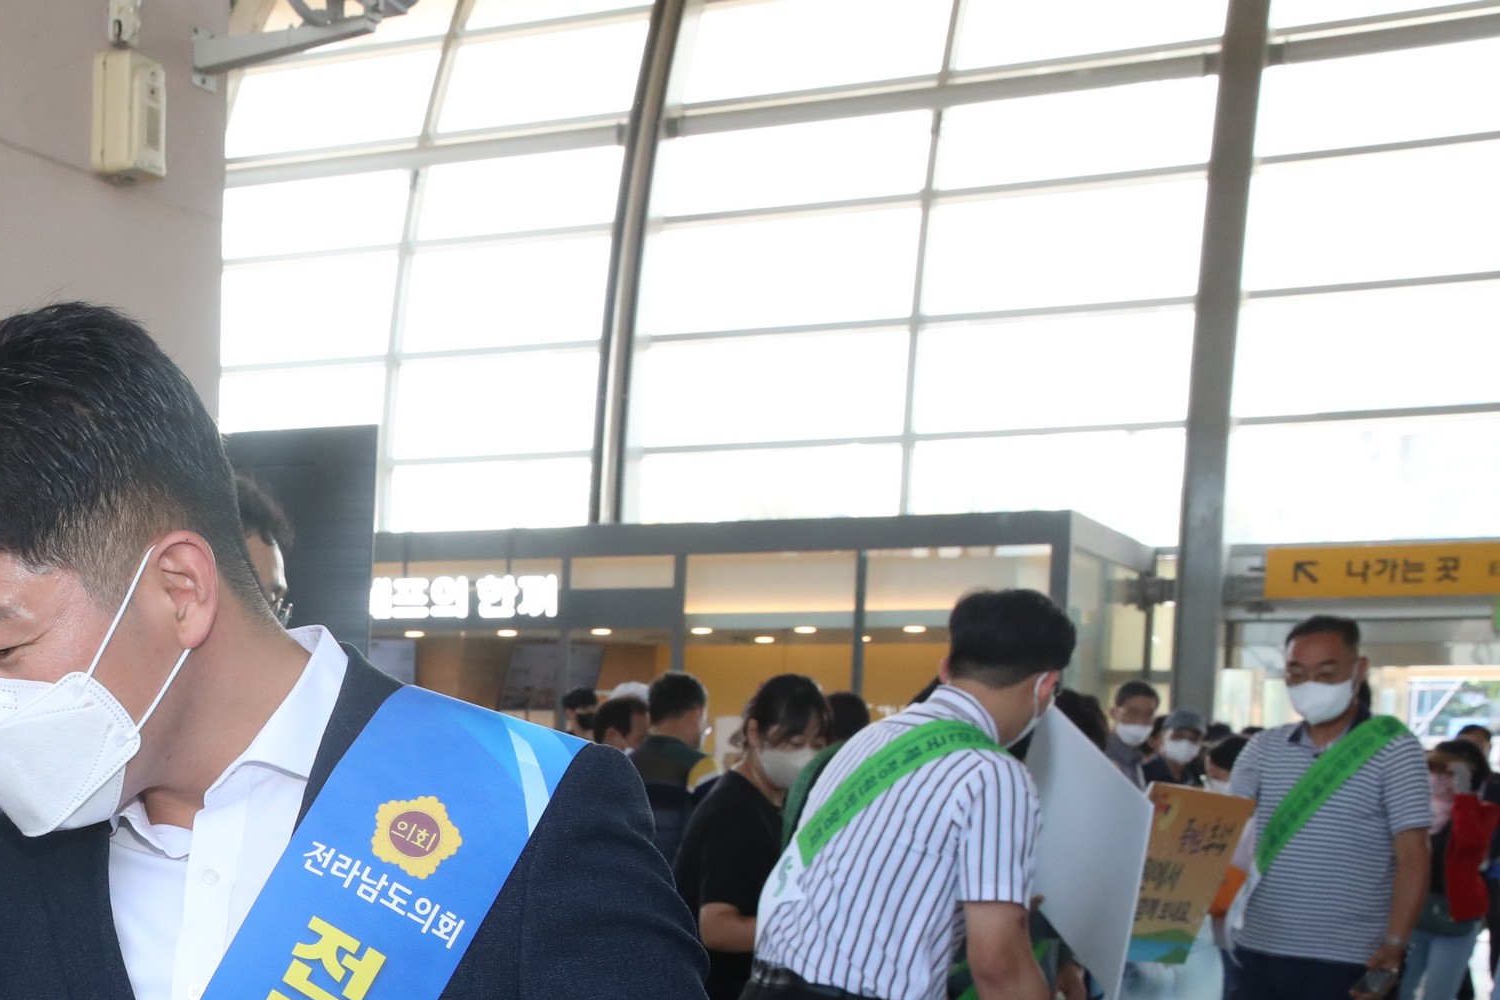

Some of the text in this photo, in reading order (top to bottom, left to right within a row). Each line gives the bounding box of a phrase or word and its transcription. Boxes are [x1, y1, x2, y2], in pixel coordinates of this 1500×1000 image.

[1346, 557, 1426, 585] 나가는
[1435, 555, 1461, 583] 곳
[388, 818, 437, 853] 의회
[303, 840, 464, 950] 전라남도의회
